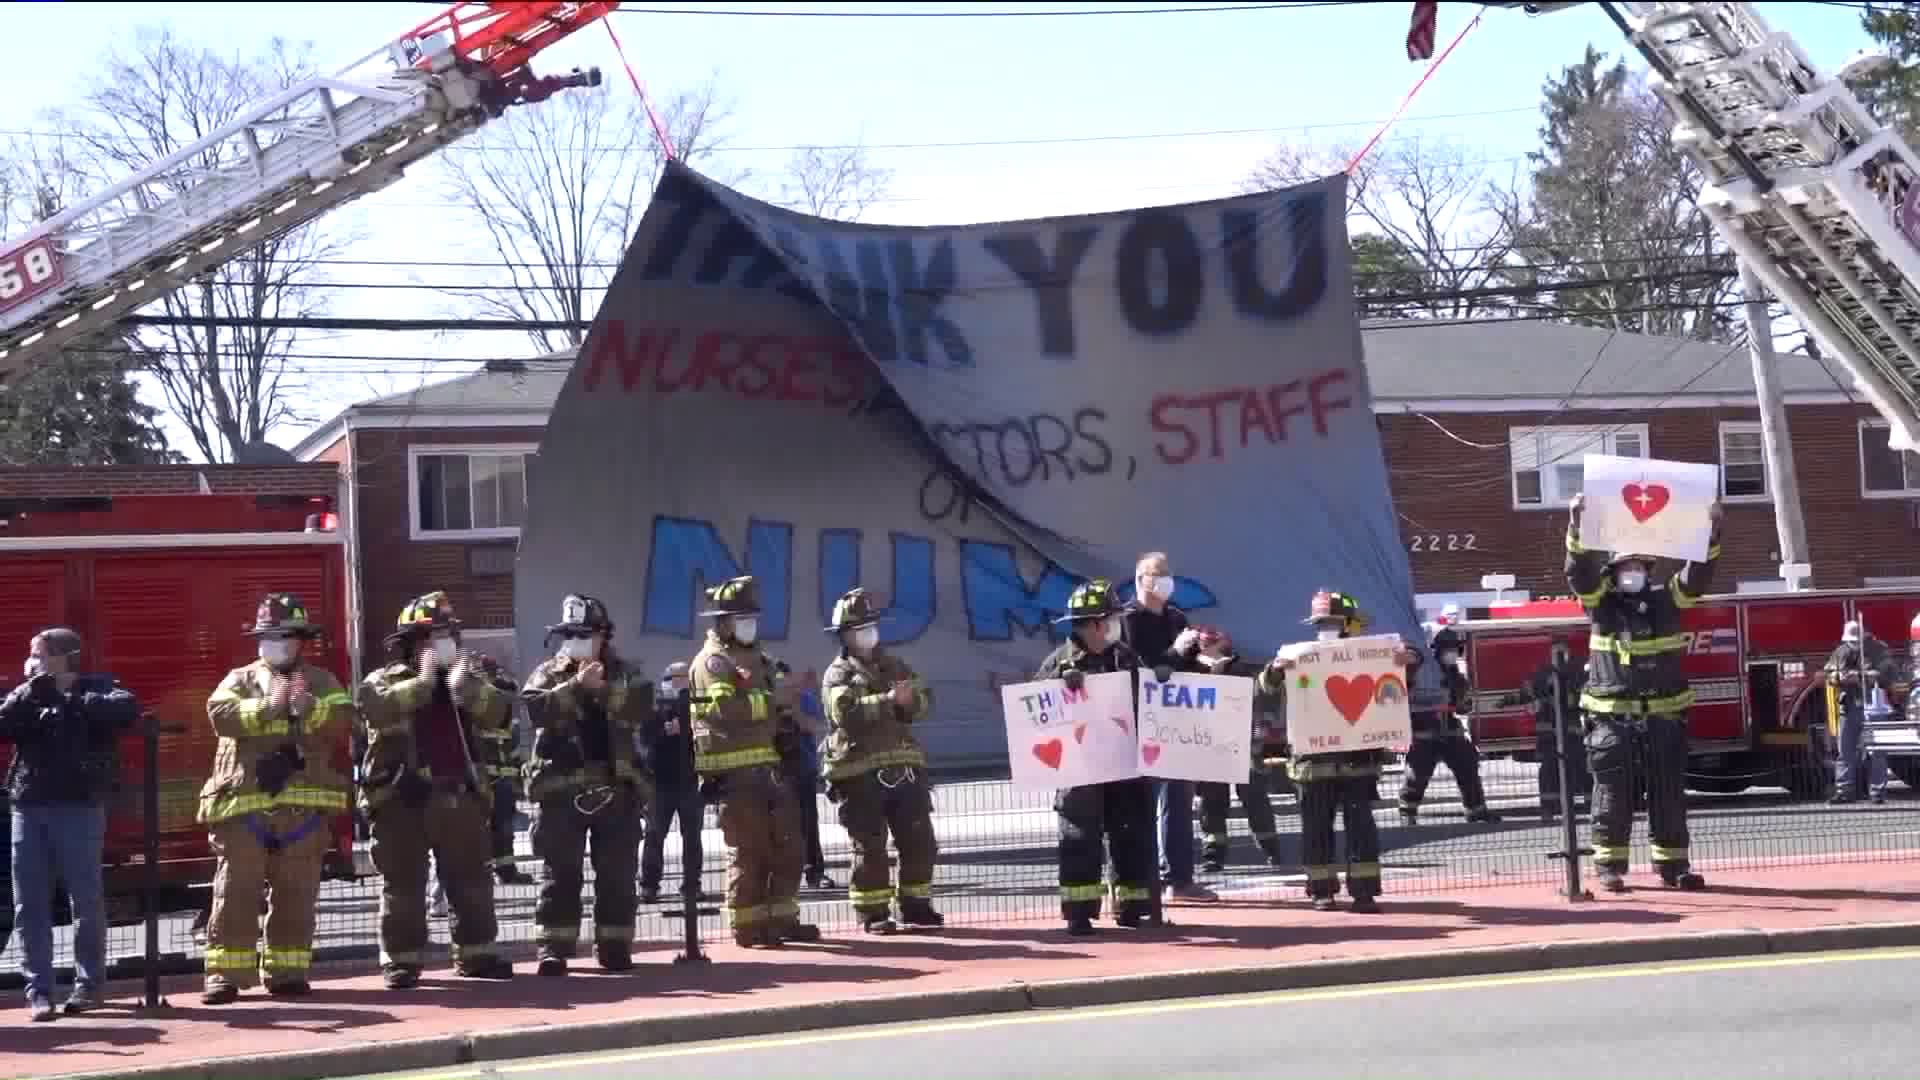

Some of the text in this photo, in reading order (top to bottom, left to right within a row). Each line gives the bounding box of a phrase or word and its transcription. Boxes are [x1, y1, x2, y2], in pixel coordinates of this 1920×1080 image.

[981, 190, 1328, 360] YOU
[1151, 372, 1352, 465] STAFF
[1411, 533, 1476, 551] 2222
[1331, 649, 1353, 663] ALL
[1143, 682, 1217, 710] TEAM
